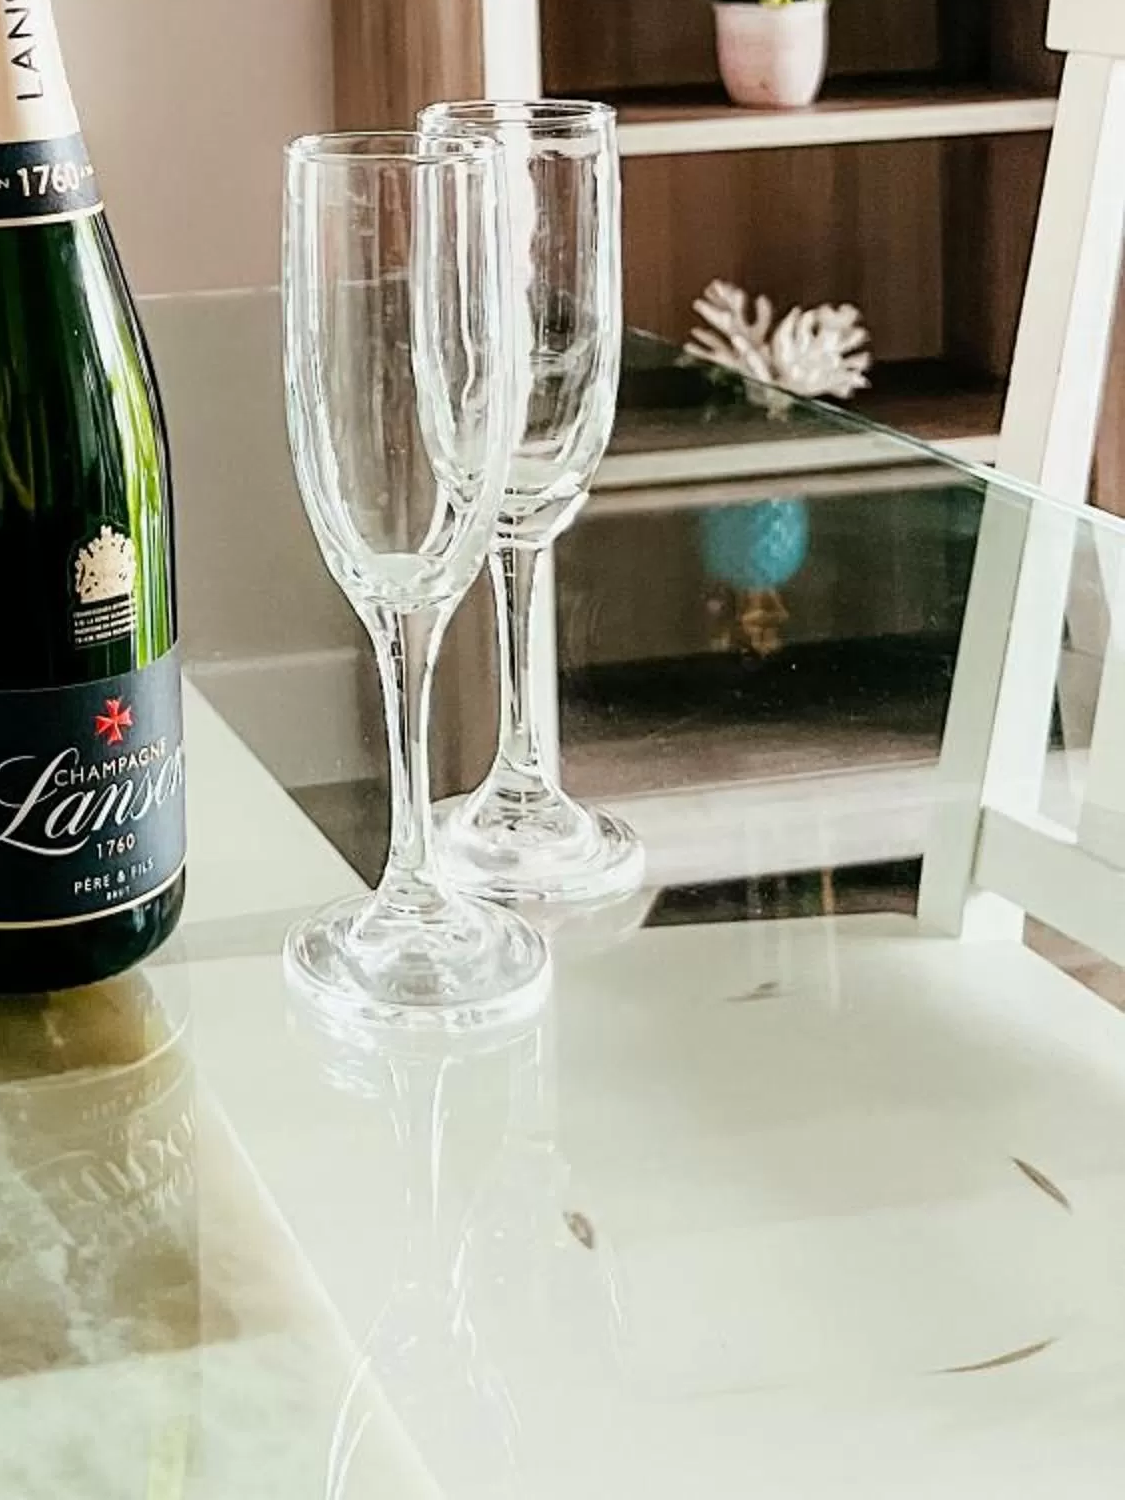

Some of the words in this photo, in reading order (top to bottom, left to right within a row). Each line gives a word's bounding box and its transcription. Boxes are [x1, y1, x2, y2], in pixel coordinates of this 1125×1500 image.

[16, 162, 80, 198] 1760
[53, 736, 167, 787] CHAMPAGNE
[96, 832, 136, 860] 1760
[116, 869, 126, 884] &
[130, 856, 155, 880] FILS
